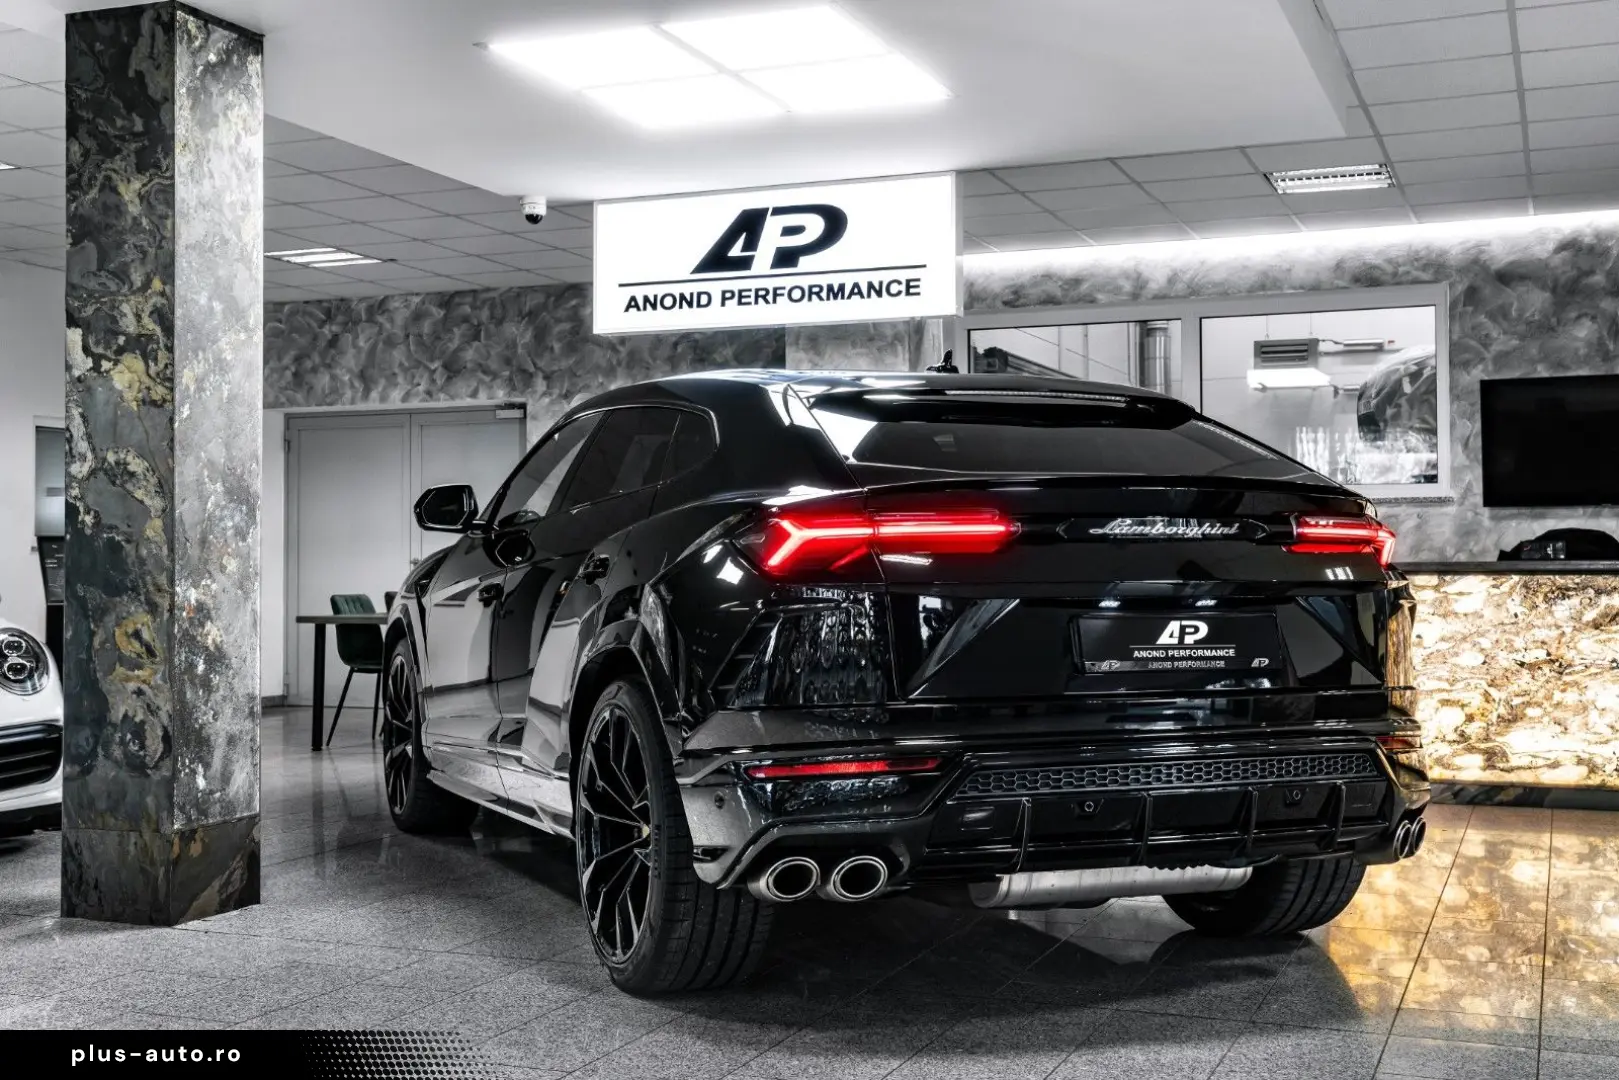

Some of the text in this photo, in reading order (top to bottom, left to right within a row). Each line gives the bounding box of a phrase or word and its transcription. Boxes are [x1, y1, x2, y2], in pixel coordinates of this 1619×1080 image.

[690, 203, 848, 275] AP
[624, 278, 921, 313] ANOND PERFORMANCE
[1089, 518, 1240, 538] Lamborghini
[1156, 620, 1209, 645] AP
[1133, 648, 1236, 658] ANOND PERFORMANCE
[1251, 657, 1270, 668] AP
[1148, 660, 1226, 669] ANOND PERFORMANCE
